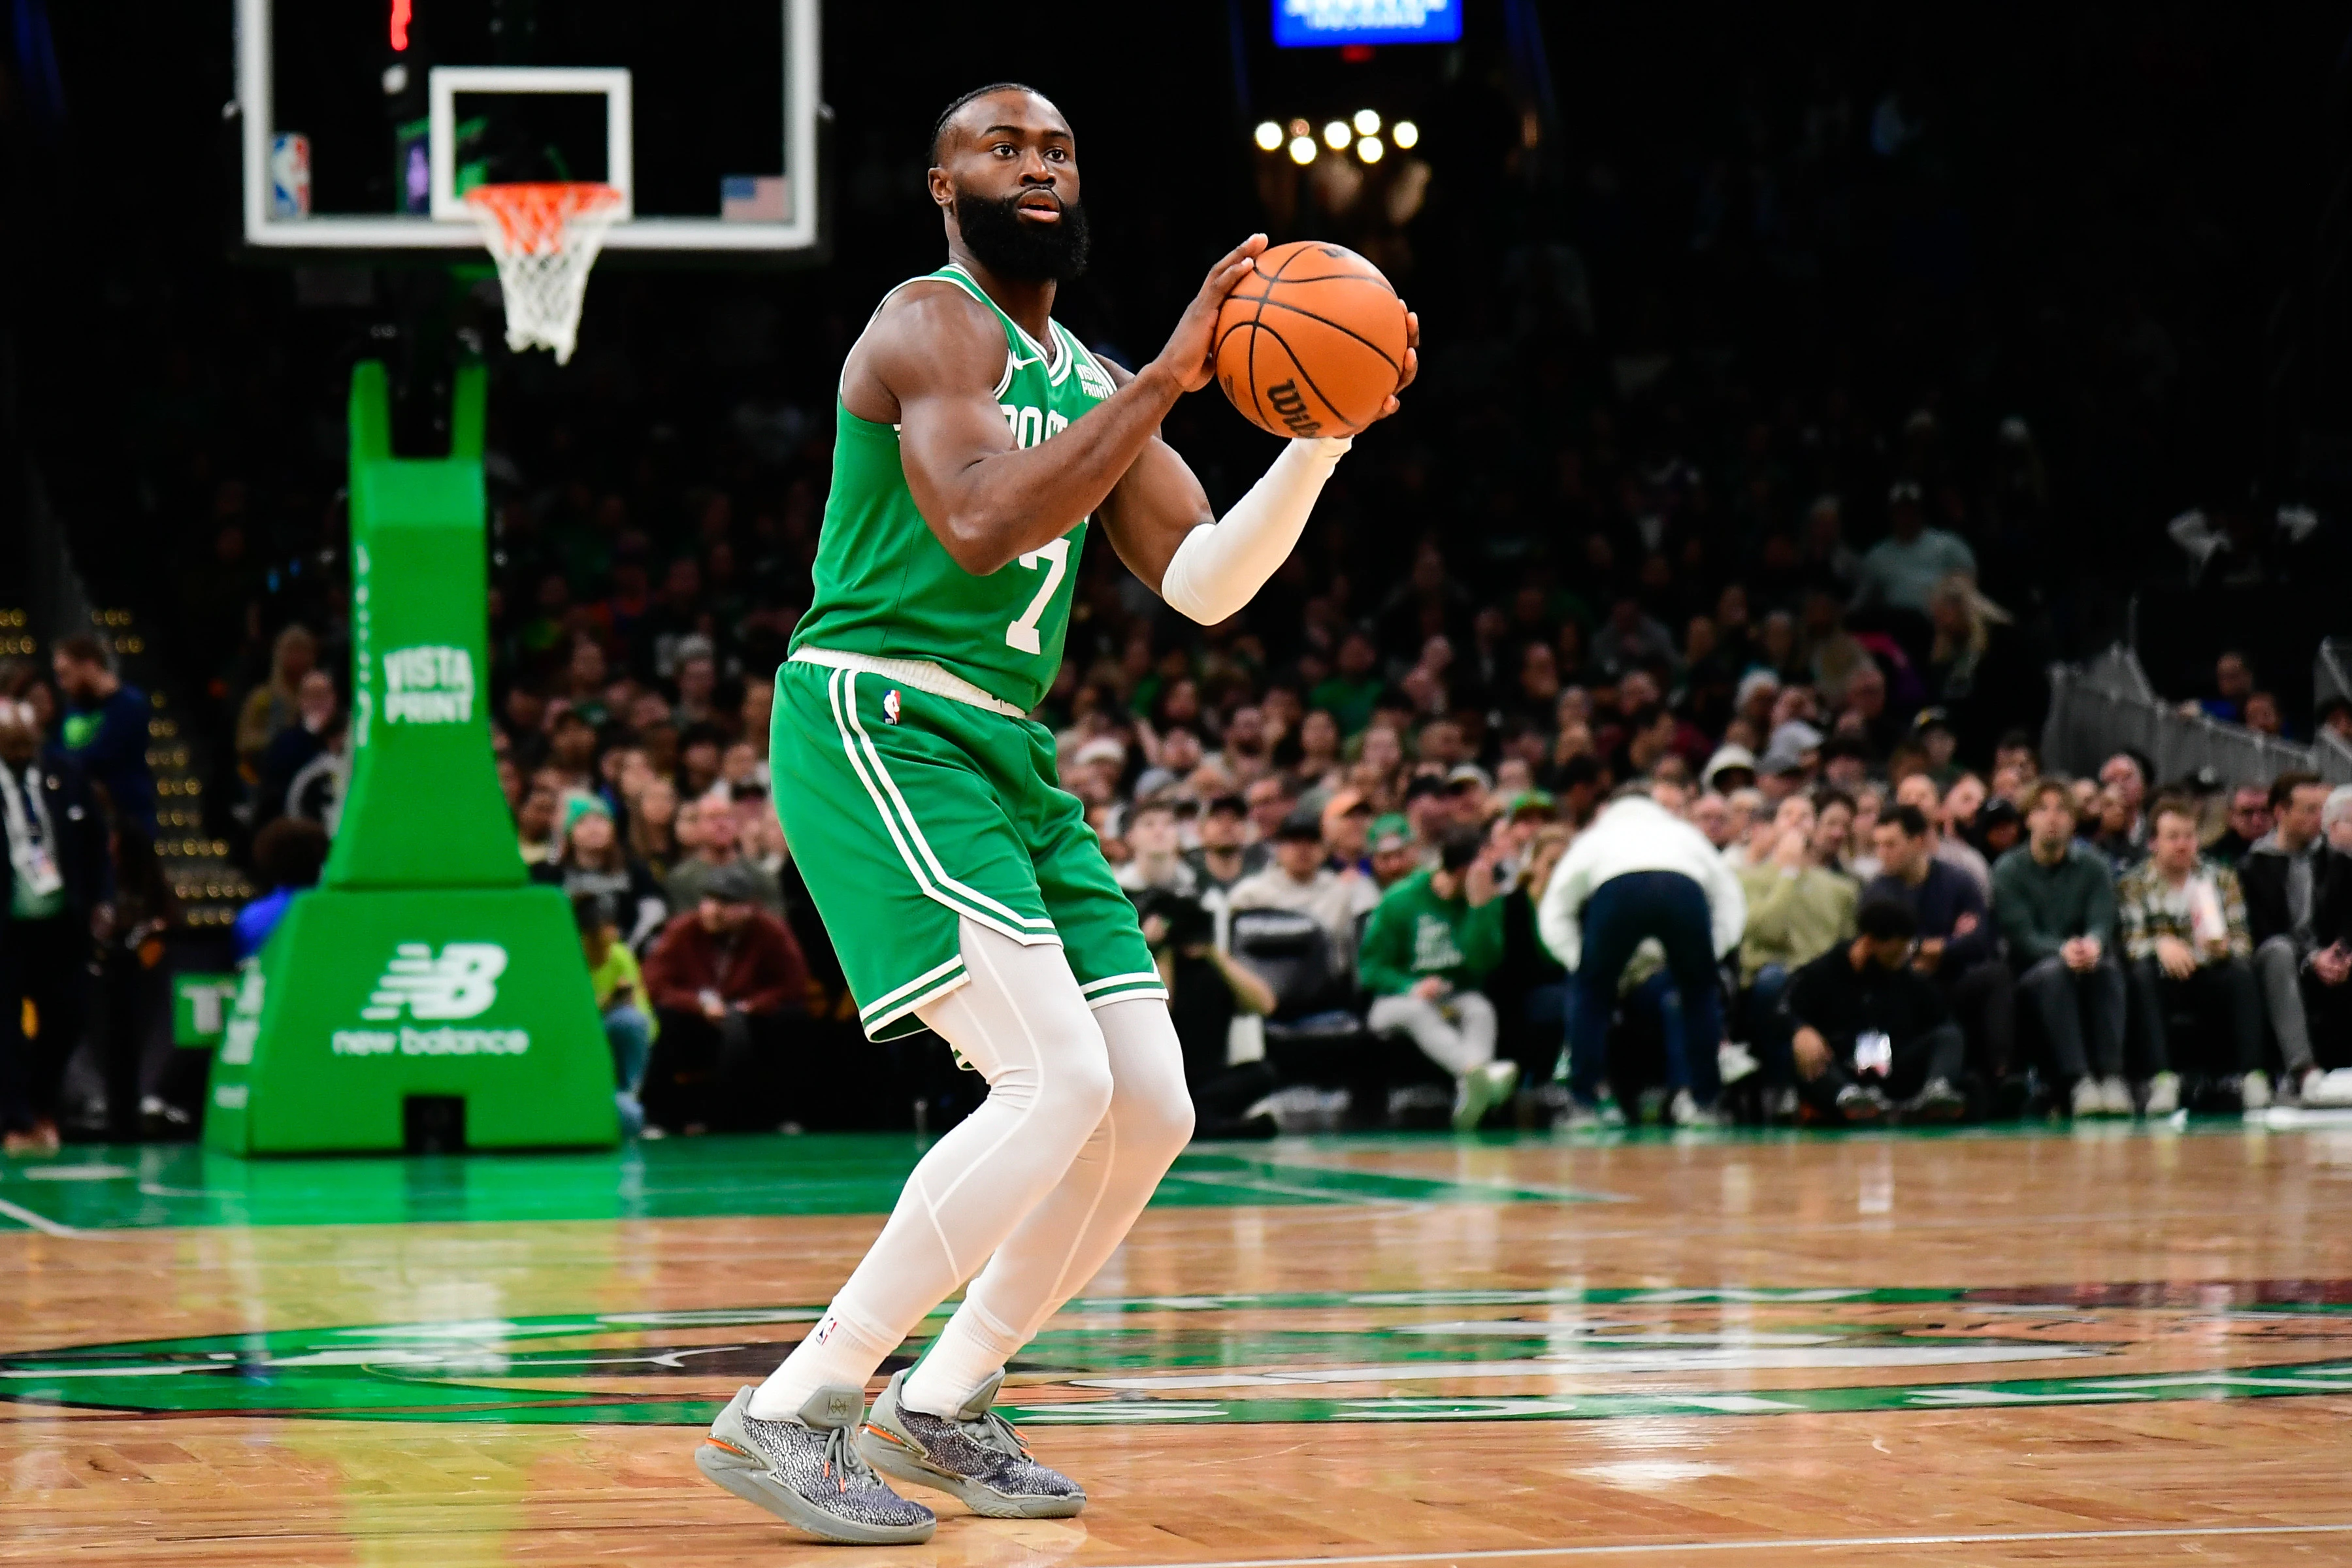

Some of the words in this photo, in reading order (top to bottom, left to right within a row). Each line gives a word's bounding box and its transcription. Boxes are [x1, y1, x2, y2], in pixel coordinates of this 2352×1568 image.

[1081, 380, 1109, 399] PRINT
[1006, 536, 1071, 655] 7
[384, 645, 474, 690] VISTA
[384, 691, 473, 723] PRINT
[332, 1030, 397, 1055] new
[400, 1026, 530, 1055] balance
